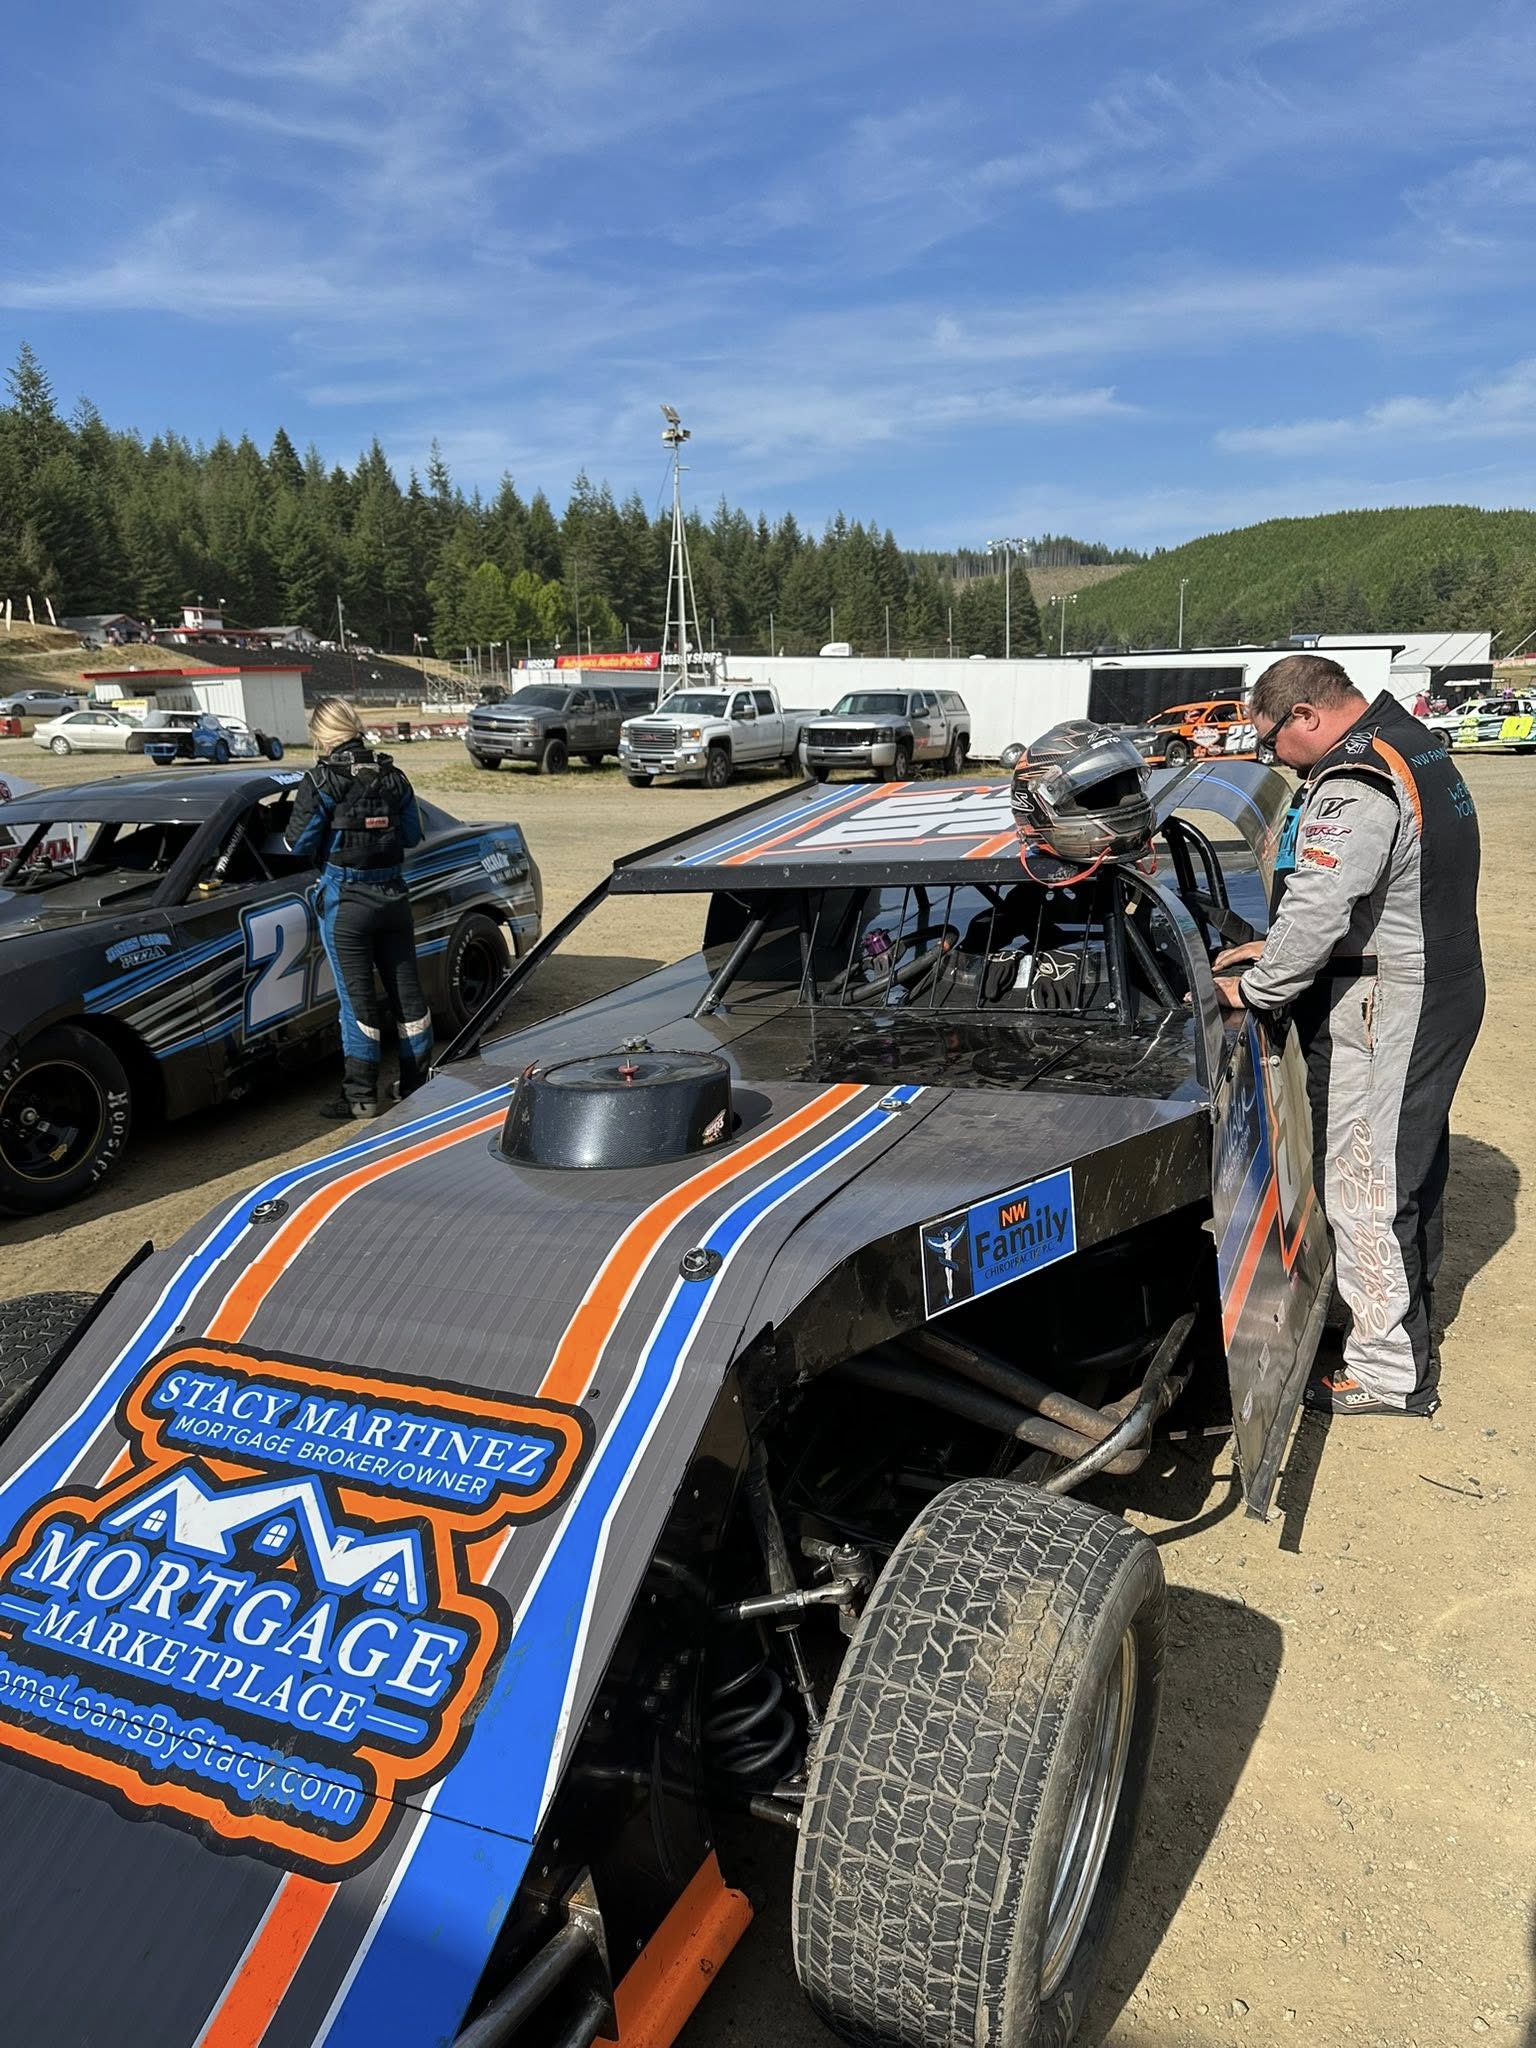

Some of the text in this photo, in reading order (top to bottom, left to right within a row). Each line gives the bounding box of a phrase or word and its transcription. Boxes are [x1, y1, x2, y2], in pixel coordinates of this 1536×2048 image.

[527, 658, 555, 669] NASCAR
[563, 655, 644, 669] Advance Auto Parts
[1410, 751, 1431, 768] NW
[119, 945, 167, 969] PIZZA
[975, 1204, 1068, 1270] Family
[1001, 1201, 1027, 1228] NW
[1336, 1118, 1388, 1344] Ester Lee
[1371, 1164, 1401, 1299] MOTEL
[158, 1375, 547, 1479] STACY MARTINEZ
[174, 1415, 488, 1498] MORTGAGE BROKER/OWNER
[26, 1529, 459, 1699] MORTGAGE
[32, 1602, 367, 1734] MARKETPLACE
[0, 1668, 358, 1815] omeLoansByStacy.com
